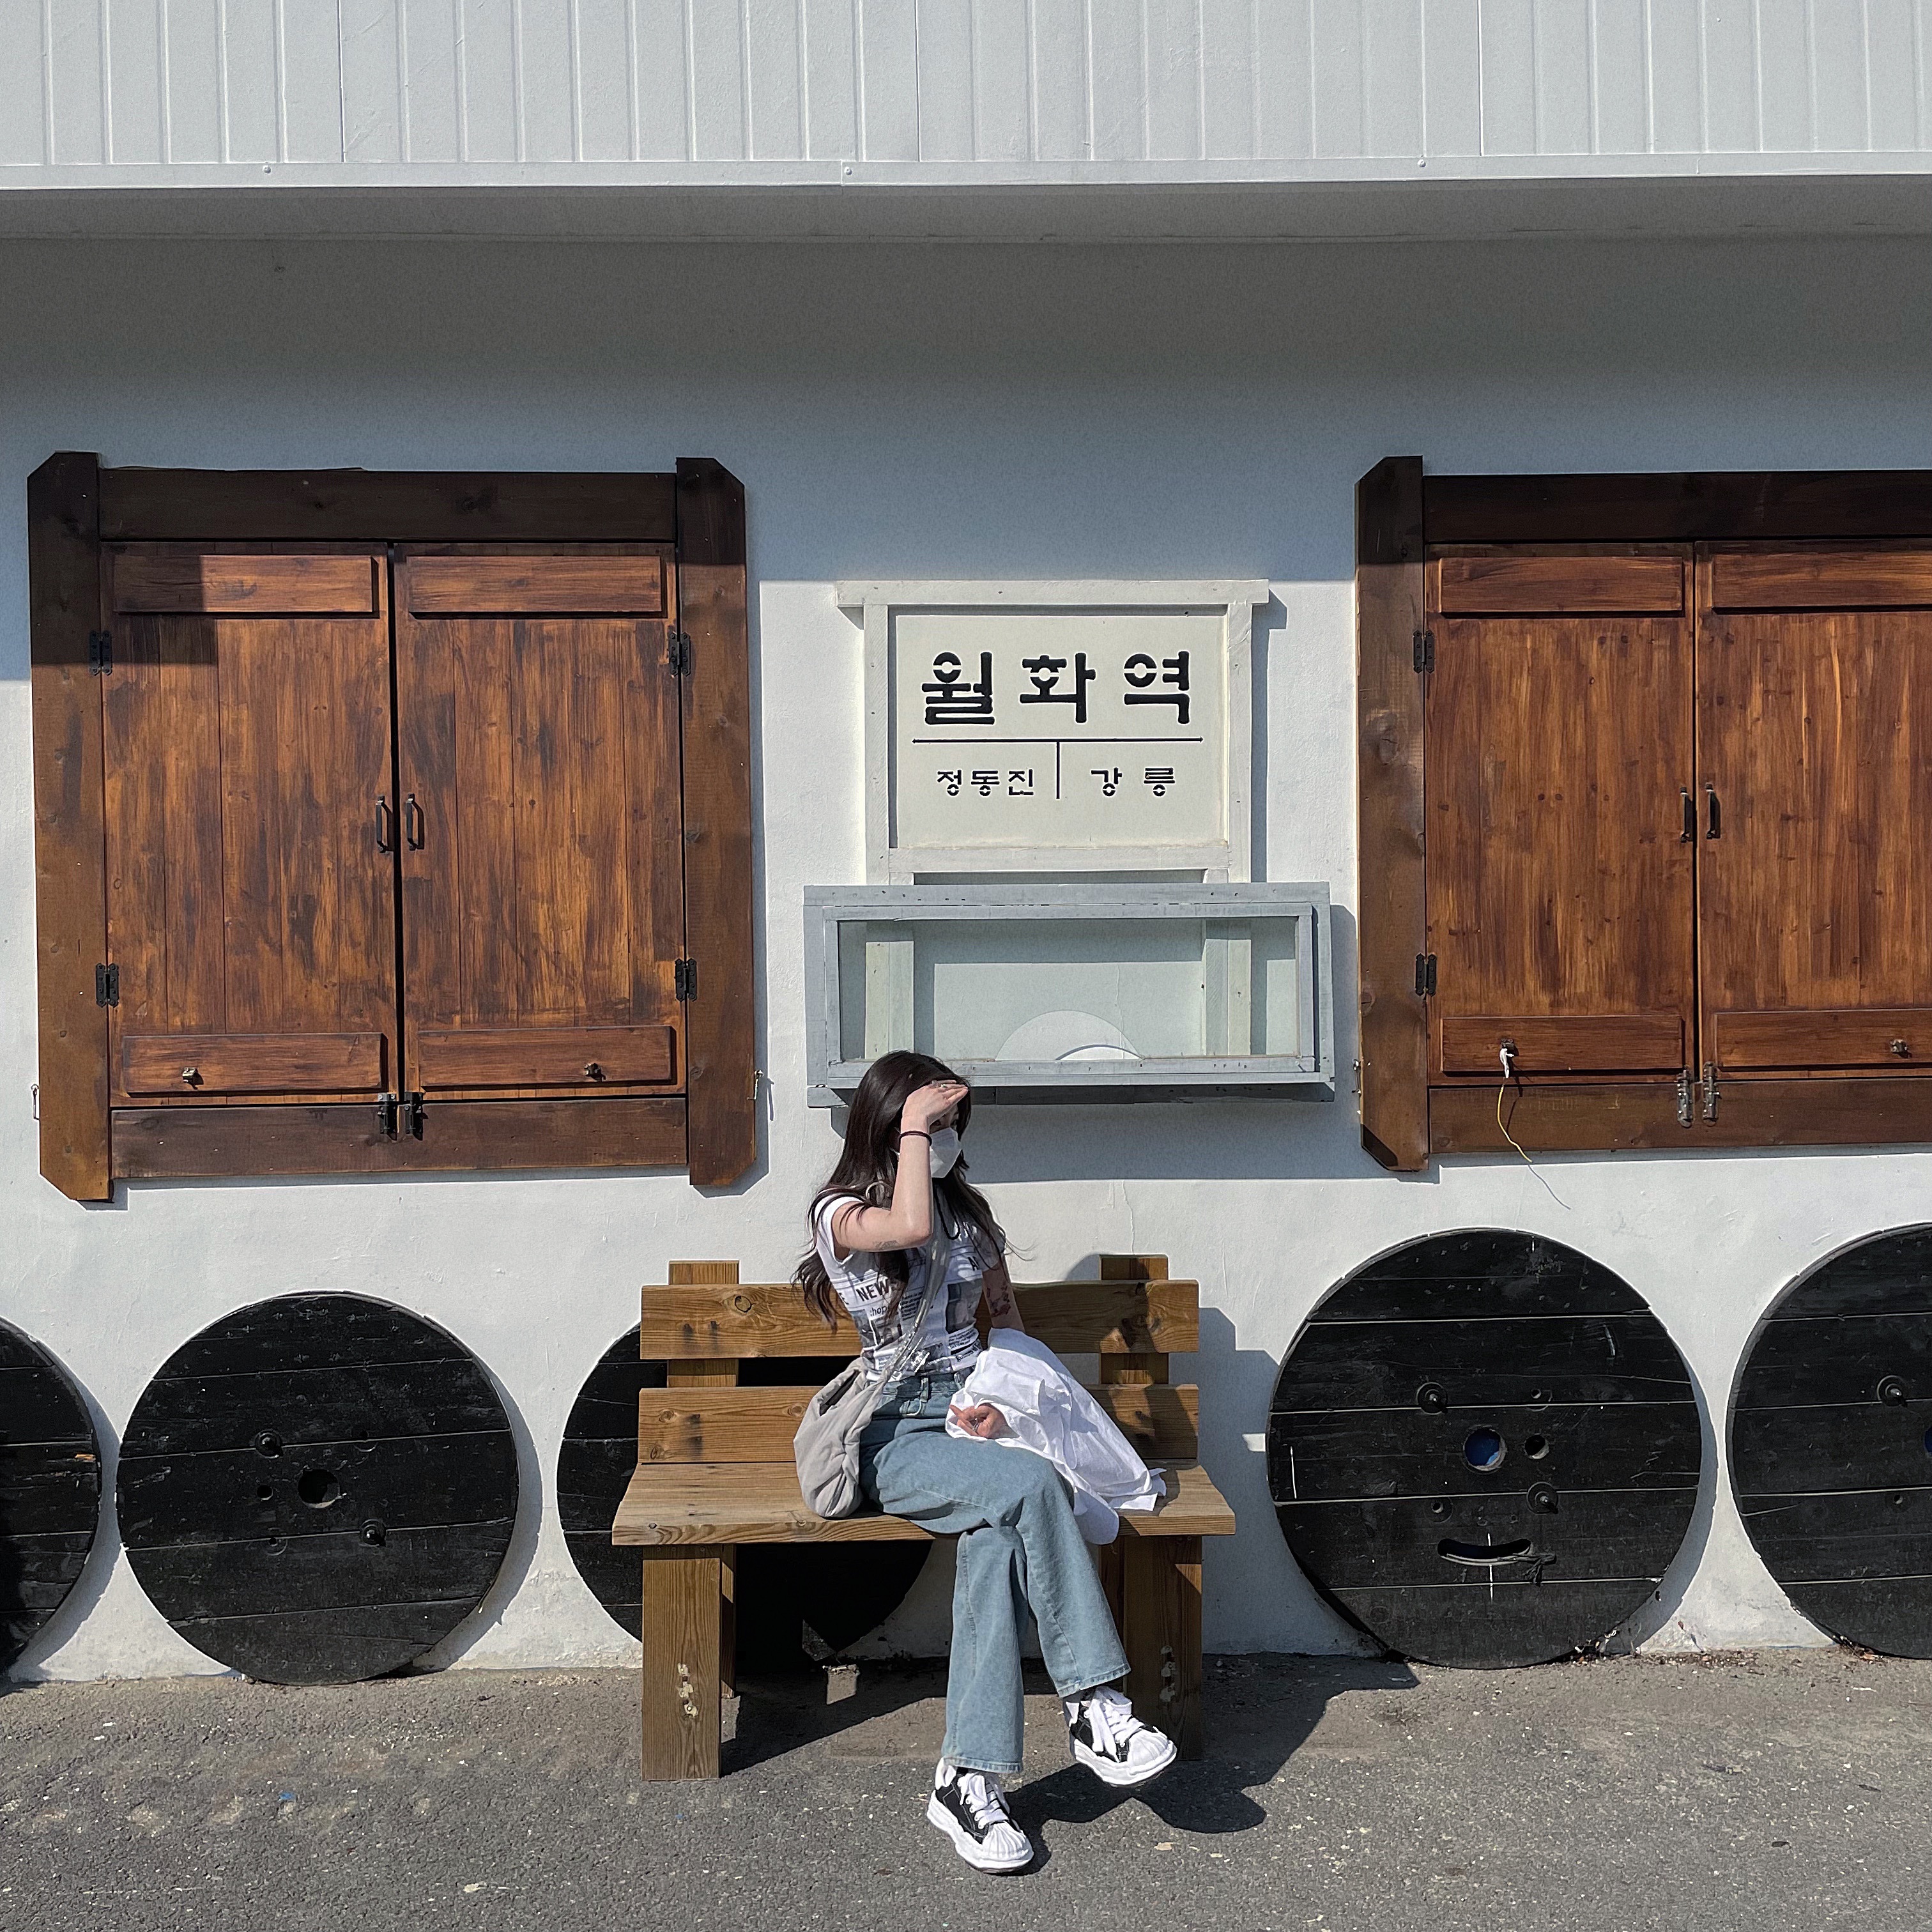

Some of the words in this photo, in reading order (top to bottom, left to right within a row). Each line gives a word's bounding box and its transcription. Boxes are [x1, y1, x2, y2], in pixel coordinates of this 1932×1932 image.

[921, 650, 1190, 725] 월화역
[937, 769, 1034, 797] 정동진
[1091, 767, 1176, 797] 강릉
